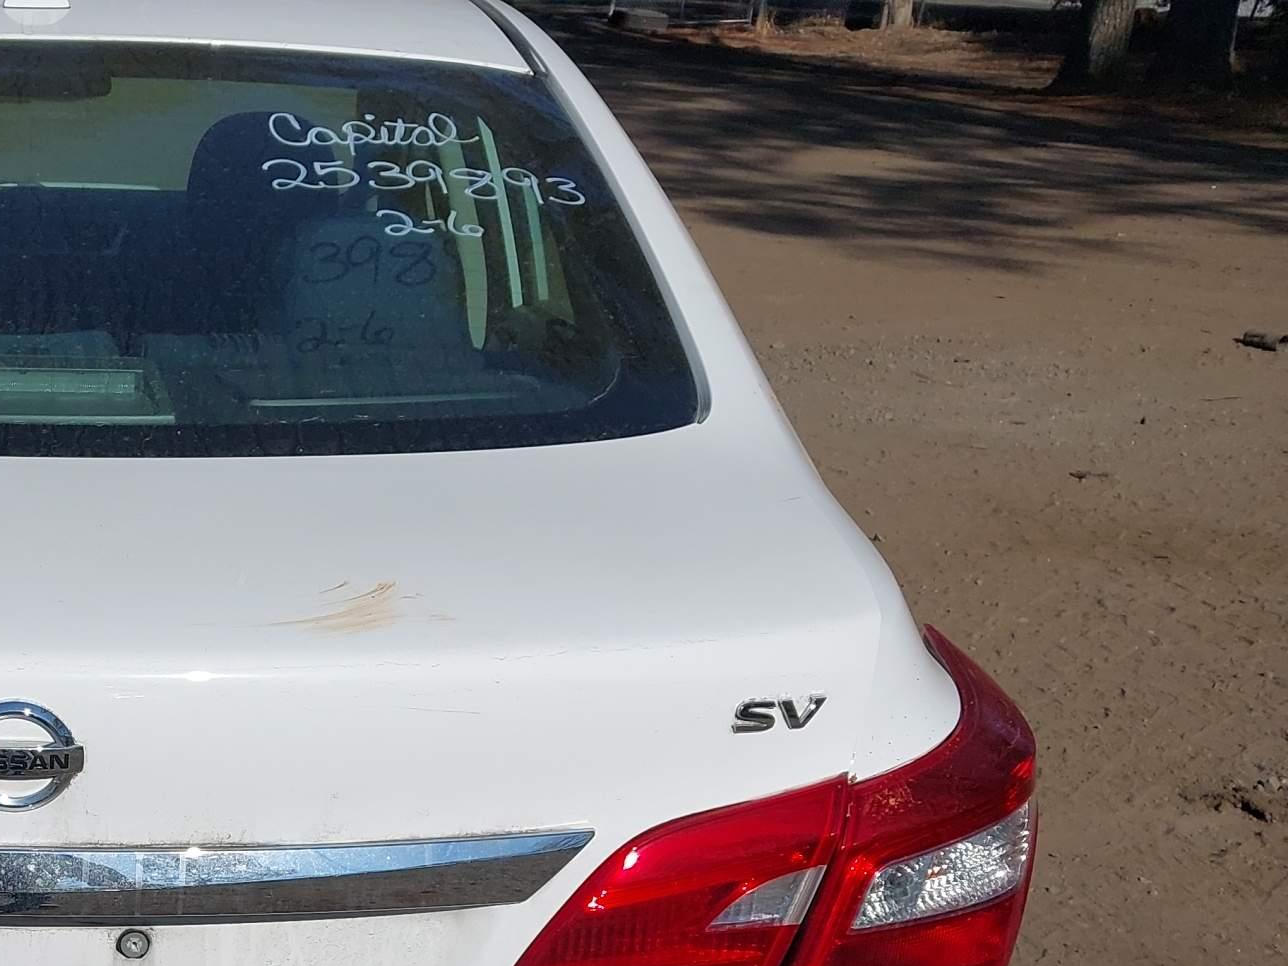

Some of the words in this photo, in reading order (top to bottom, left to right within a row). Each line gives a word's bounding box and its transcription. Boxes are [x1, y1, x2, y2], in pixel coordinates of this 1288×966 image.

[268, 112, 480, 155] Capital
[376, 209, 486, 238] 2-6
[731, 693, 828, 734] SV
